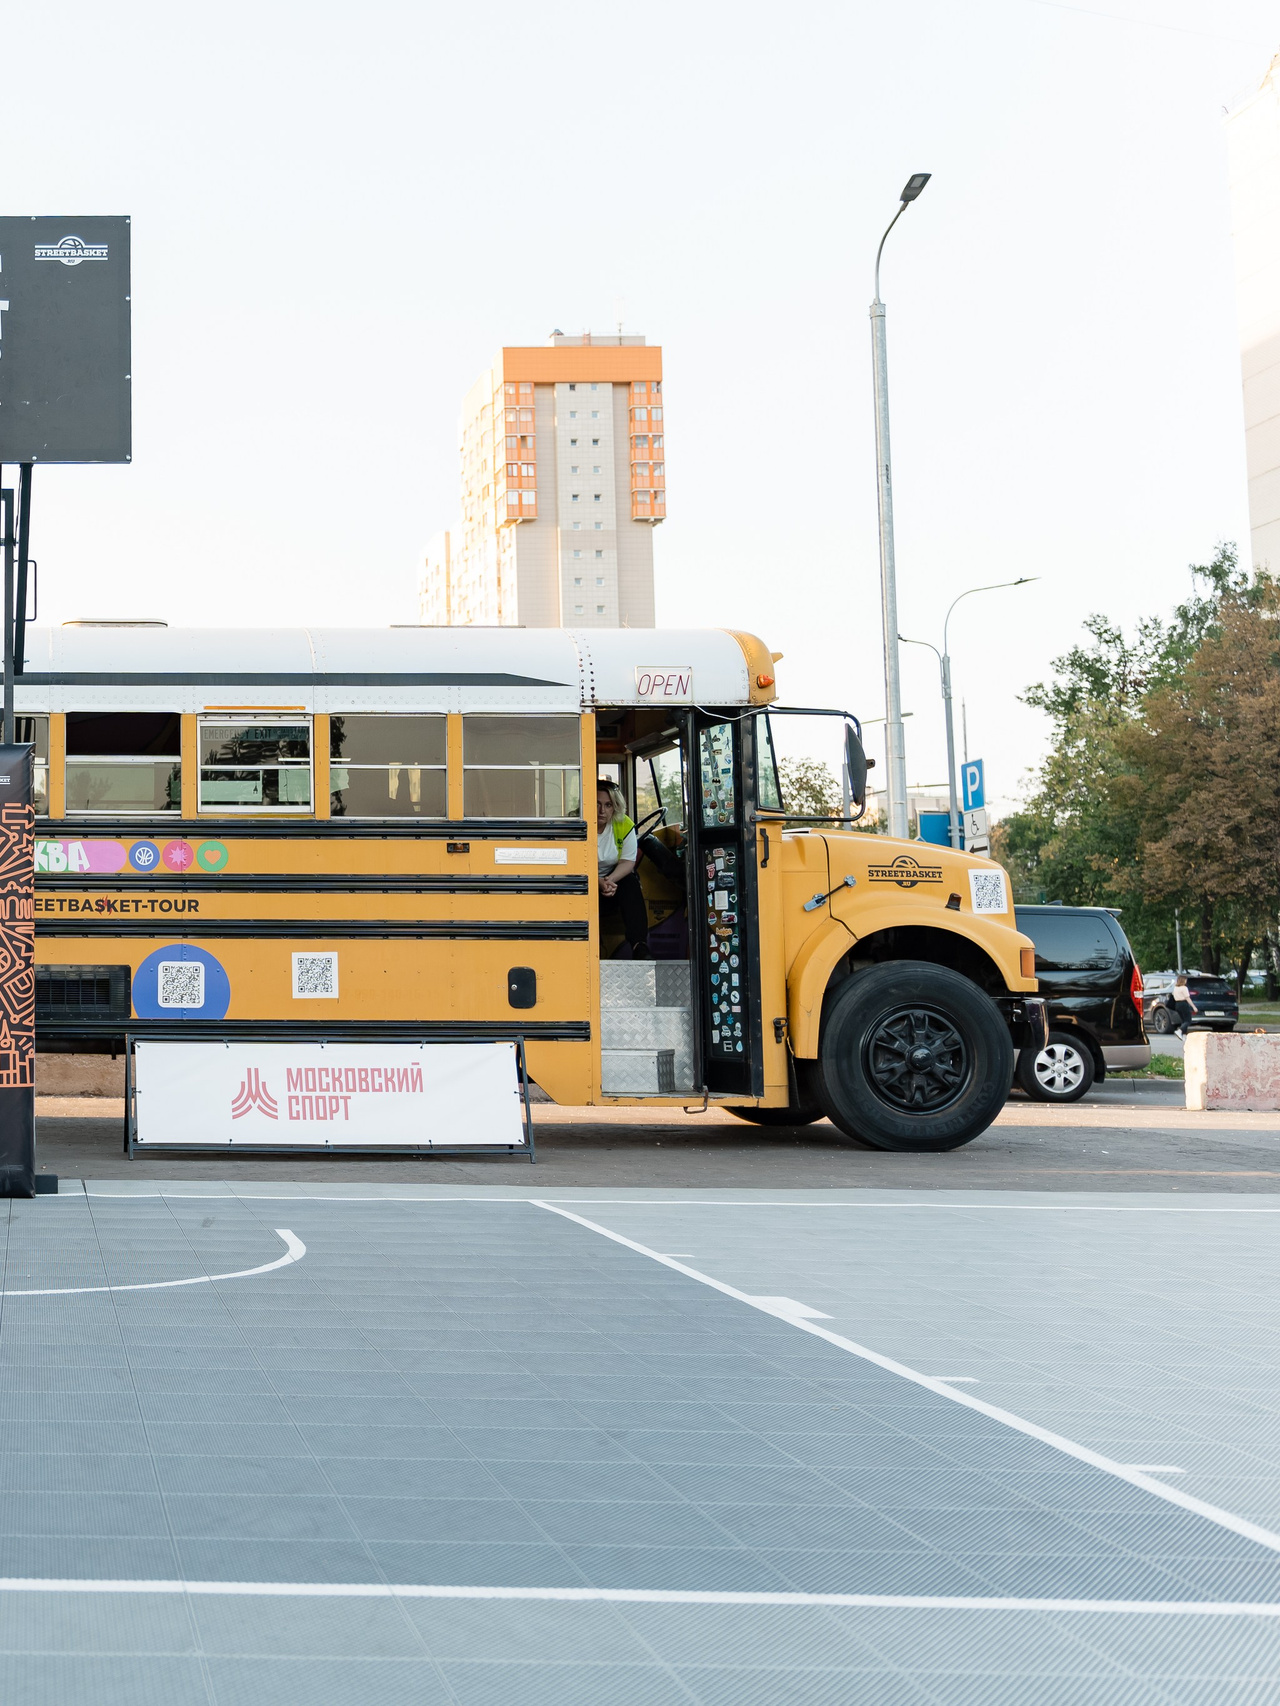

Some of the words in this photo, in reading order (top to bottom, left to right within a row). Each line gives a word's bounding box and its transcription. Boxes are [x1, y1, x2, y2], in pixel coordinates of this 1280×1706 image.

[34, 249, 108, 257] STREETBASKET
[637, 673, 690, 696] OPEN
[254, 728, 272, 739] EXIT
[966, 765, 980, 806] P
[34, 840, 91, 872] КВА
[868, 869, 943, 878] STREETBASKET
[34, 898, 200, 912] EETBASKET-TOUR
[286, 1062, 424, 1093] МОСКОВСКИЙ
[288, 1095, 352, 1121] СПОРТ
